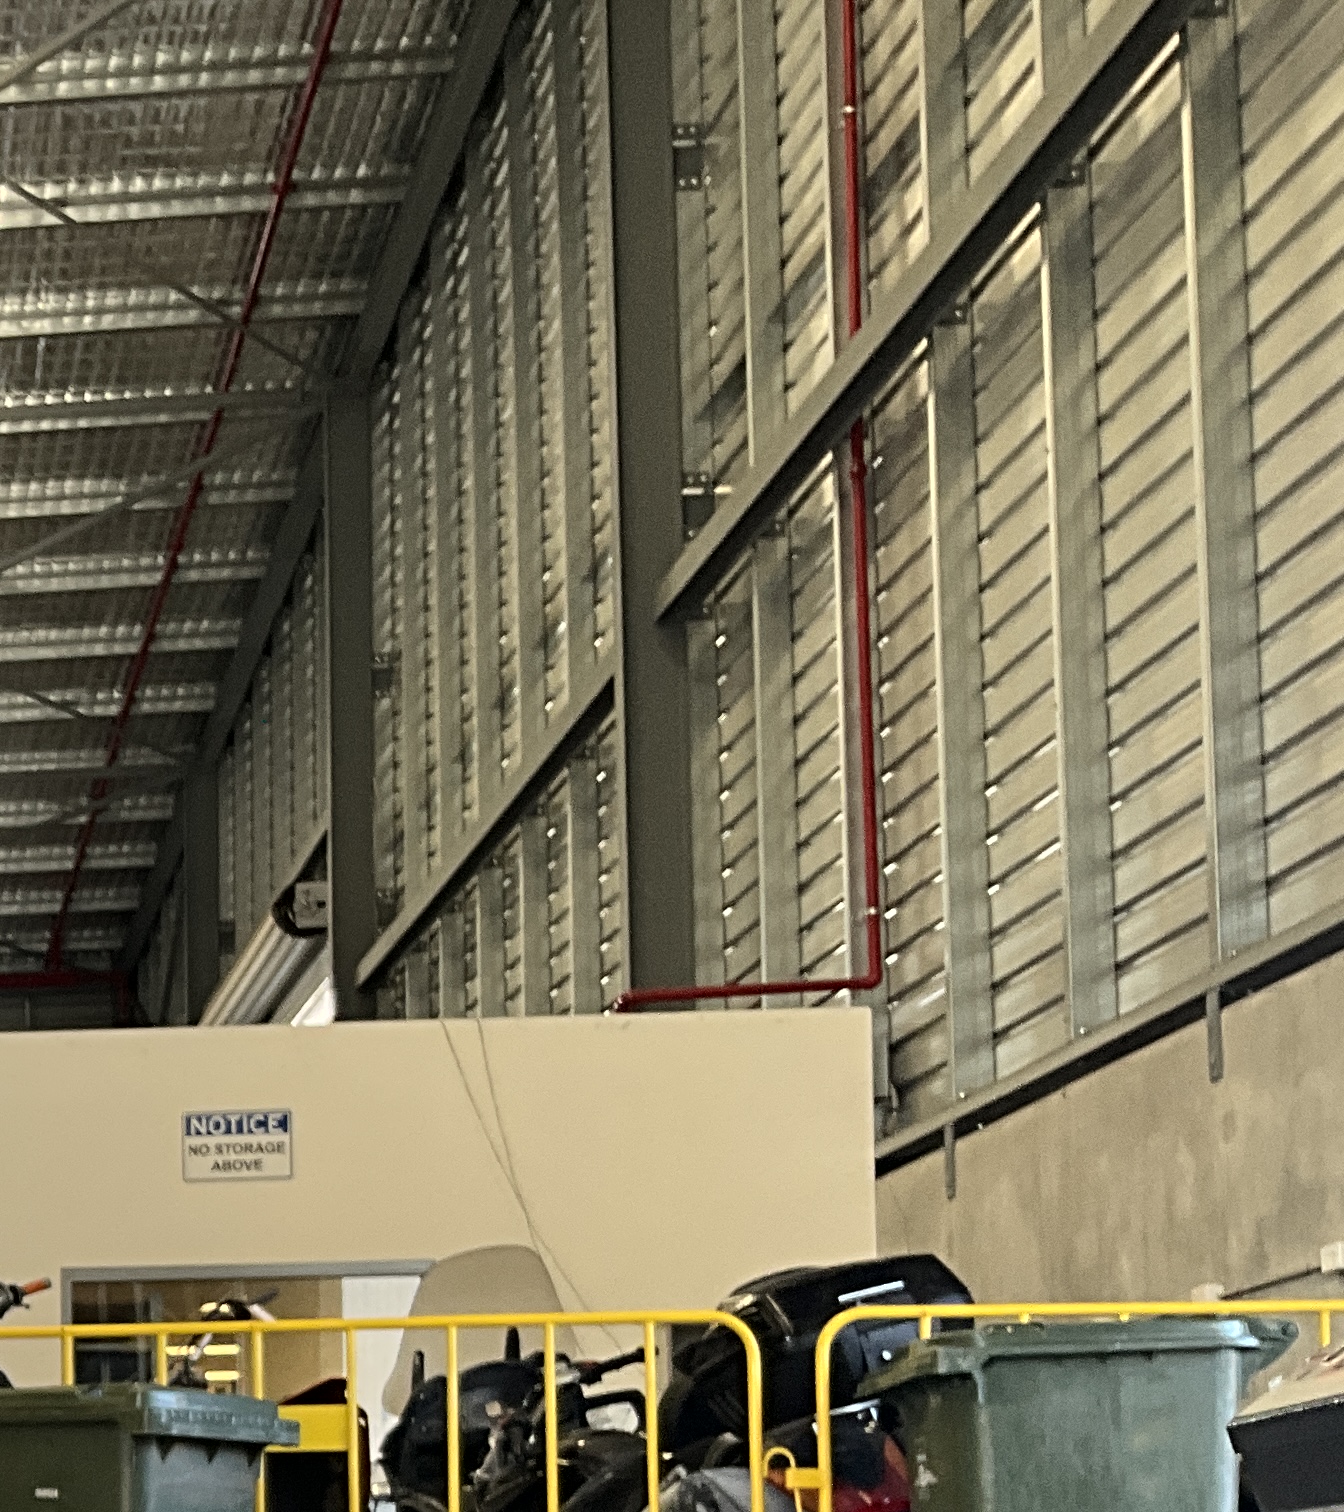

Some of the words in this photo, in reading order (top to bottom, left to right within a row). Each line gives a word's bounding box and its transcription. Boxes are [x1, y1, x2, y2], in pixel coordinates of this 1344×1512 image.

[190, 1112, 287, 1135] NOTICE
[189, 1143, 210, 1156] NO
[215, 1141, 285, 1155] STORAGE
[210, 1159, 263, 1172] ABOVE
